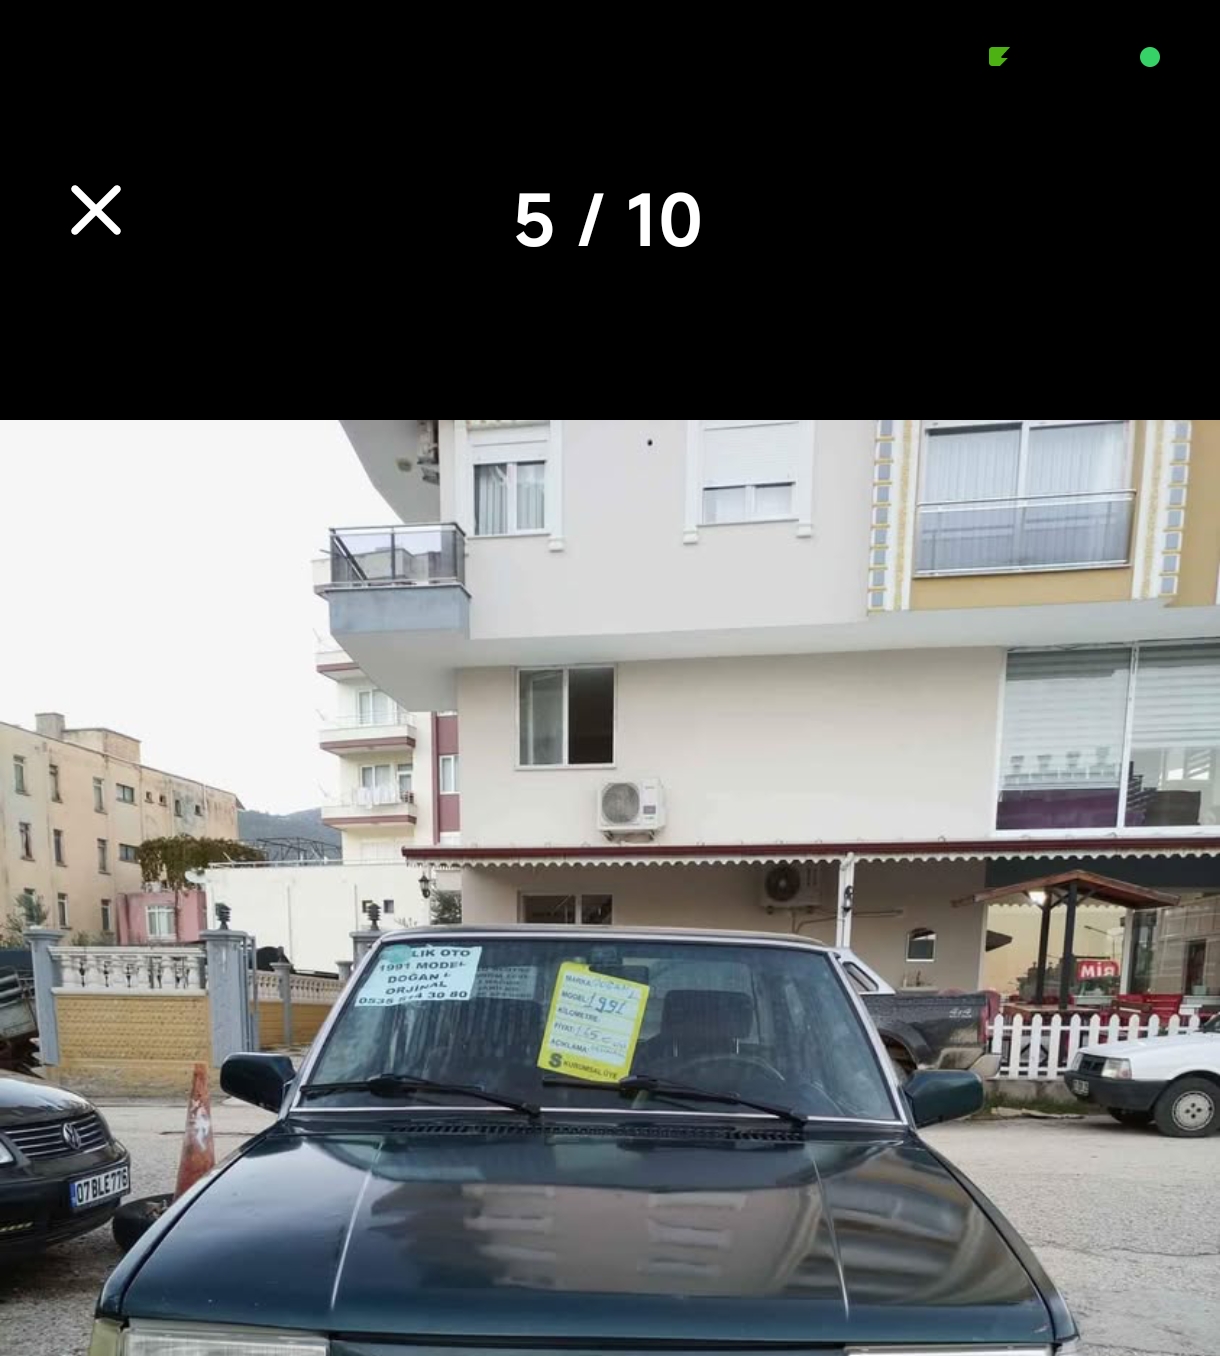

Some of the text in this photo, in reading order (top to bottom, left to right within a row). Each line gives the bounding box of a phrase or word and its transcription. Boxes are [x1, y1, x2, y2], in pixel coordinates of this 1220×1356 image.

[440, 949, 471, 958] OTO
[380, 962, 410, 972] 1991
[583, 992, 627, 1015] 1991
[549, 1053, 562, 1068] S
[77, 1180, 90, 1202] 07
[92, 1175, 109, 1198] BLE
